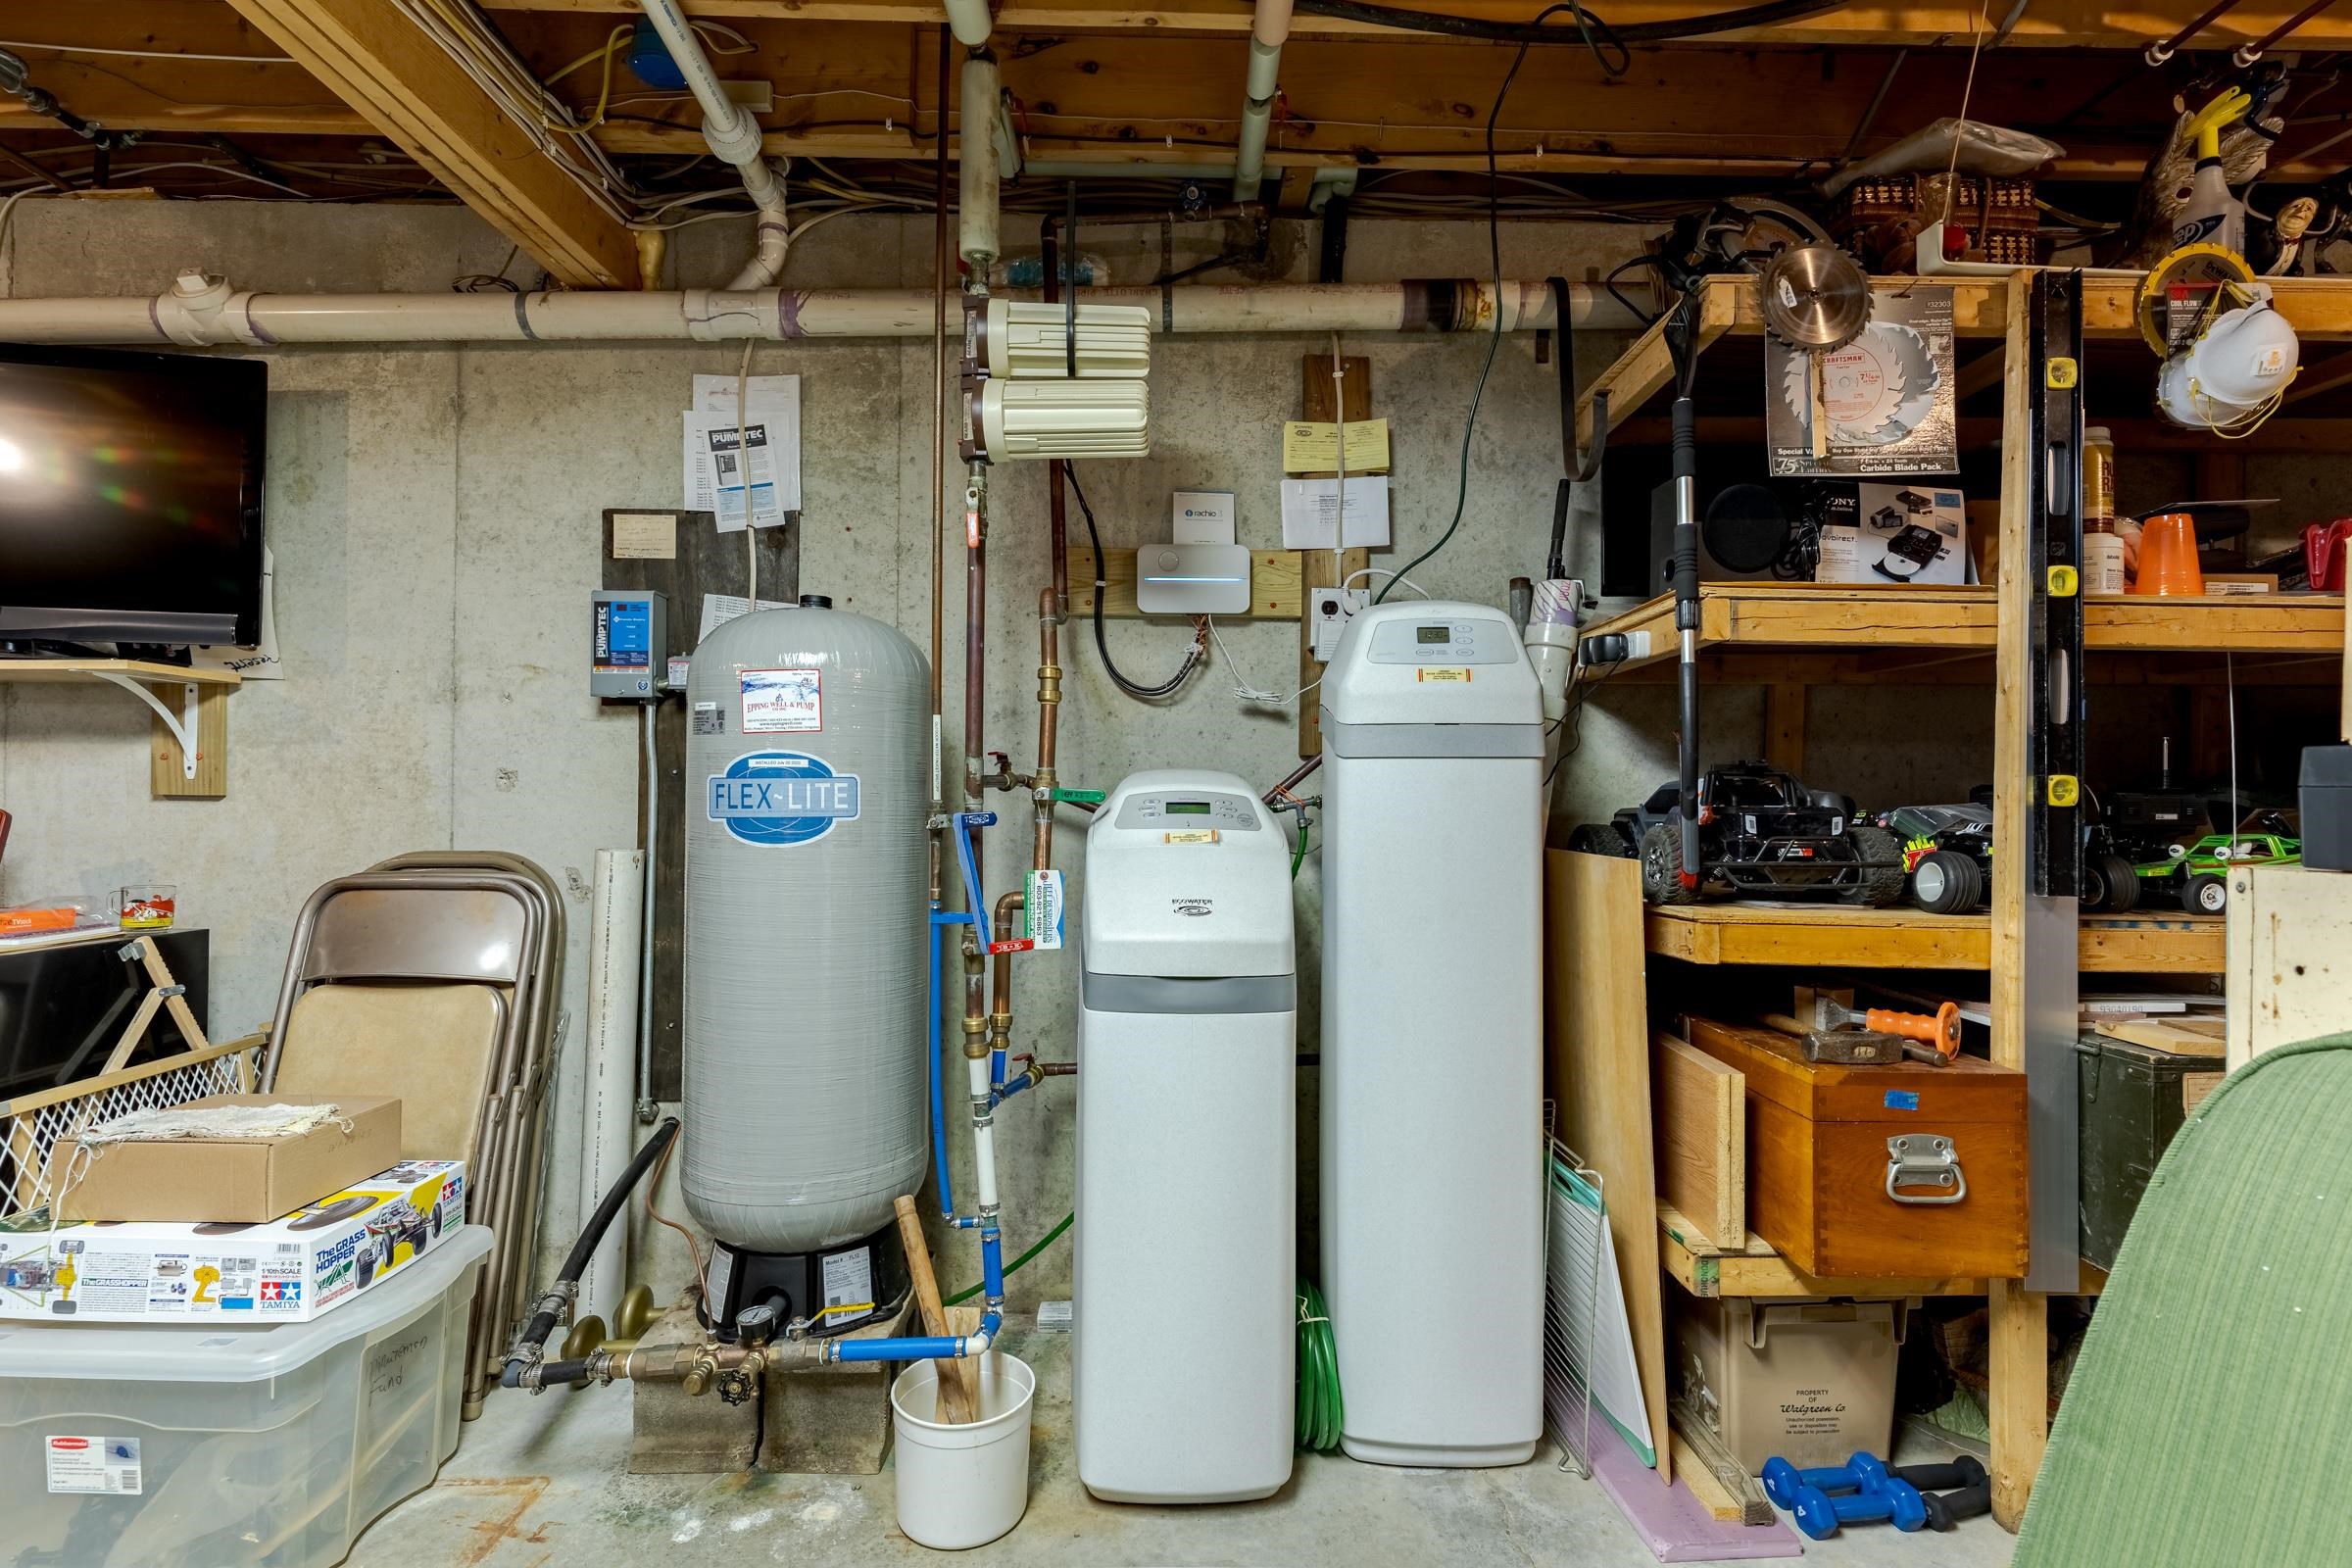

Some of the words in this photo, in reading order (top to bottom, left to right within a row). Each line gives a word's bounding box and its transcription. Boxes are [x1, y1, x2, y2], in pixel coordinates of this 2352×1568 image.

[711, 429, 763, 444] PUMTEC
[596, 607, 608, 658] PUMPTEC
[748, 702, 769, 713] EPPING
[797, 702, 815, 711] PUMP
[443, 1194, 462, 1208] TAMIYA
[316, 1247, 335, 1262] The
[335, 1229, 366, 1253] GRASS
[316, 1246, 355, 1274] HOPPER
[260, 1299, 301, 1309] TAMIYA
[1780, 1404, 1833, 1416] Walgreen
[1835, 1403, 1846, 1412] Co.
[1797, 1505, 1806, 1516] 4
